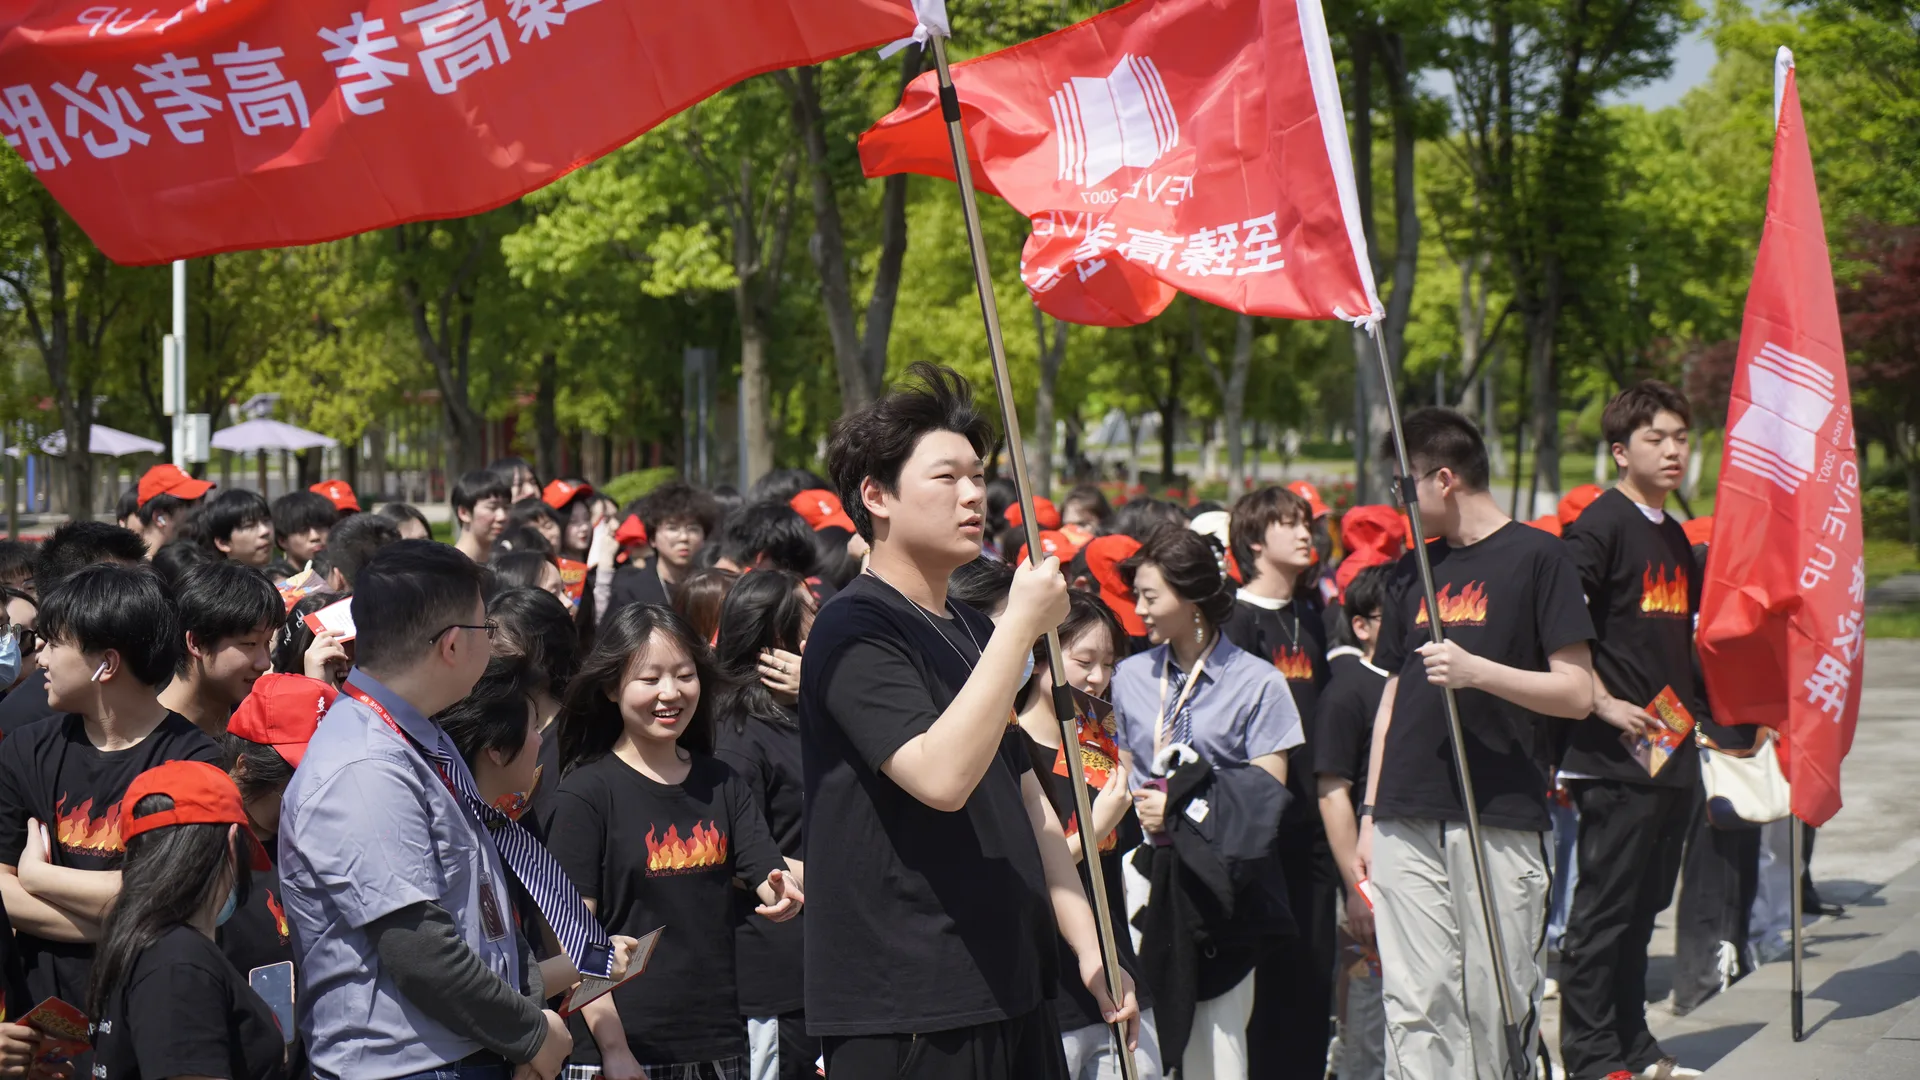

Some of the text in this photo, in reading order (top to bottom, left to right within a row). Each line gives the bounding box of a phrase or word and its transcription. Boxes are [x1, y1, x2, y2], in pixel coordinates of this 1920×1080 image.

[360, 694, 399, 732] NEVER GIVE UP
